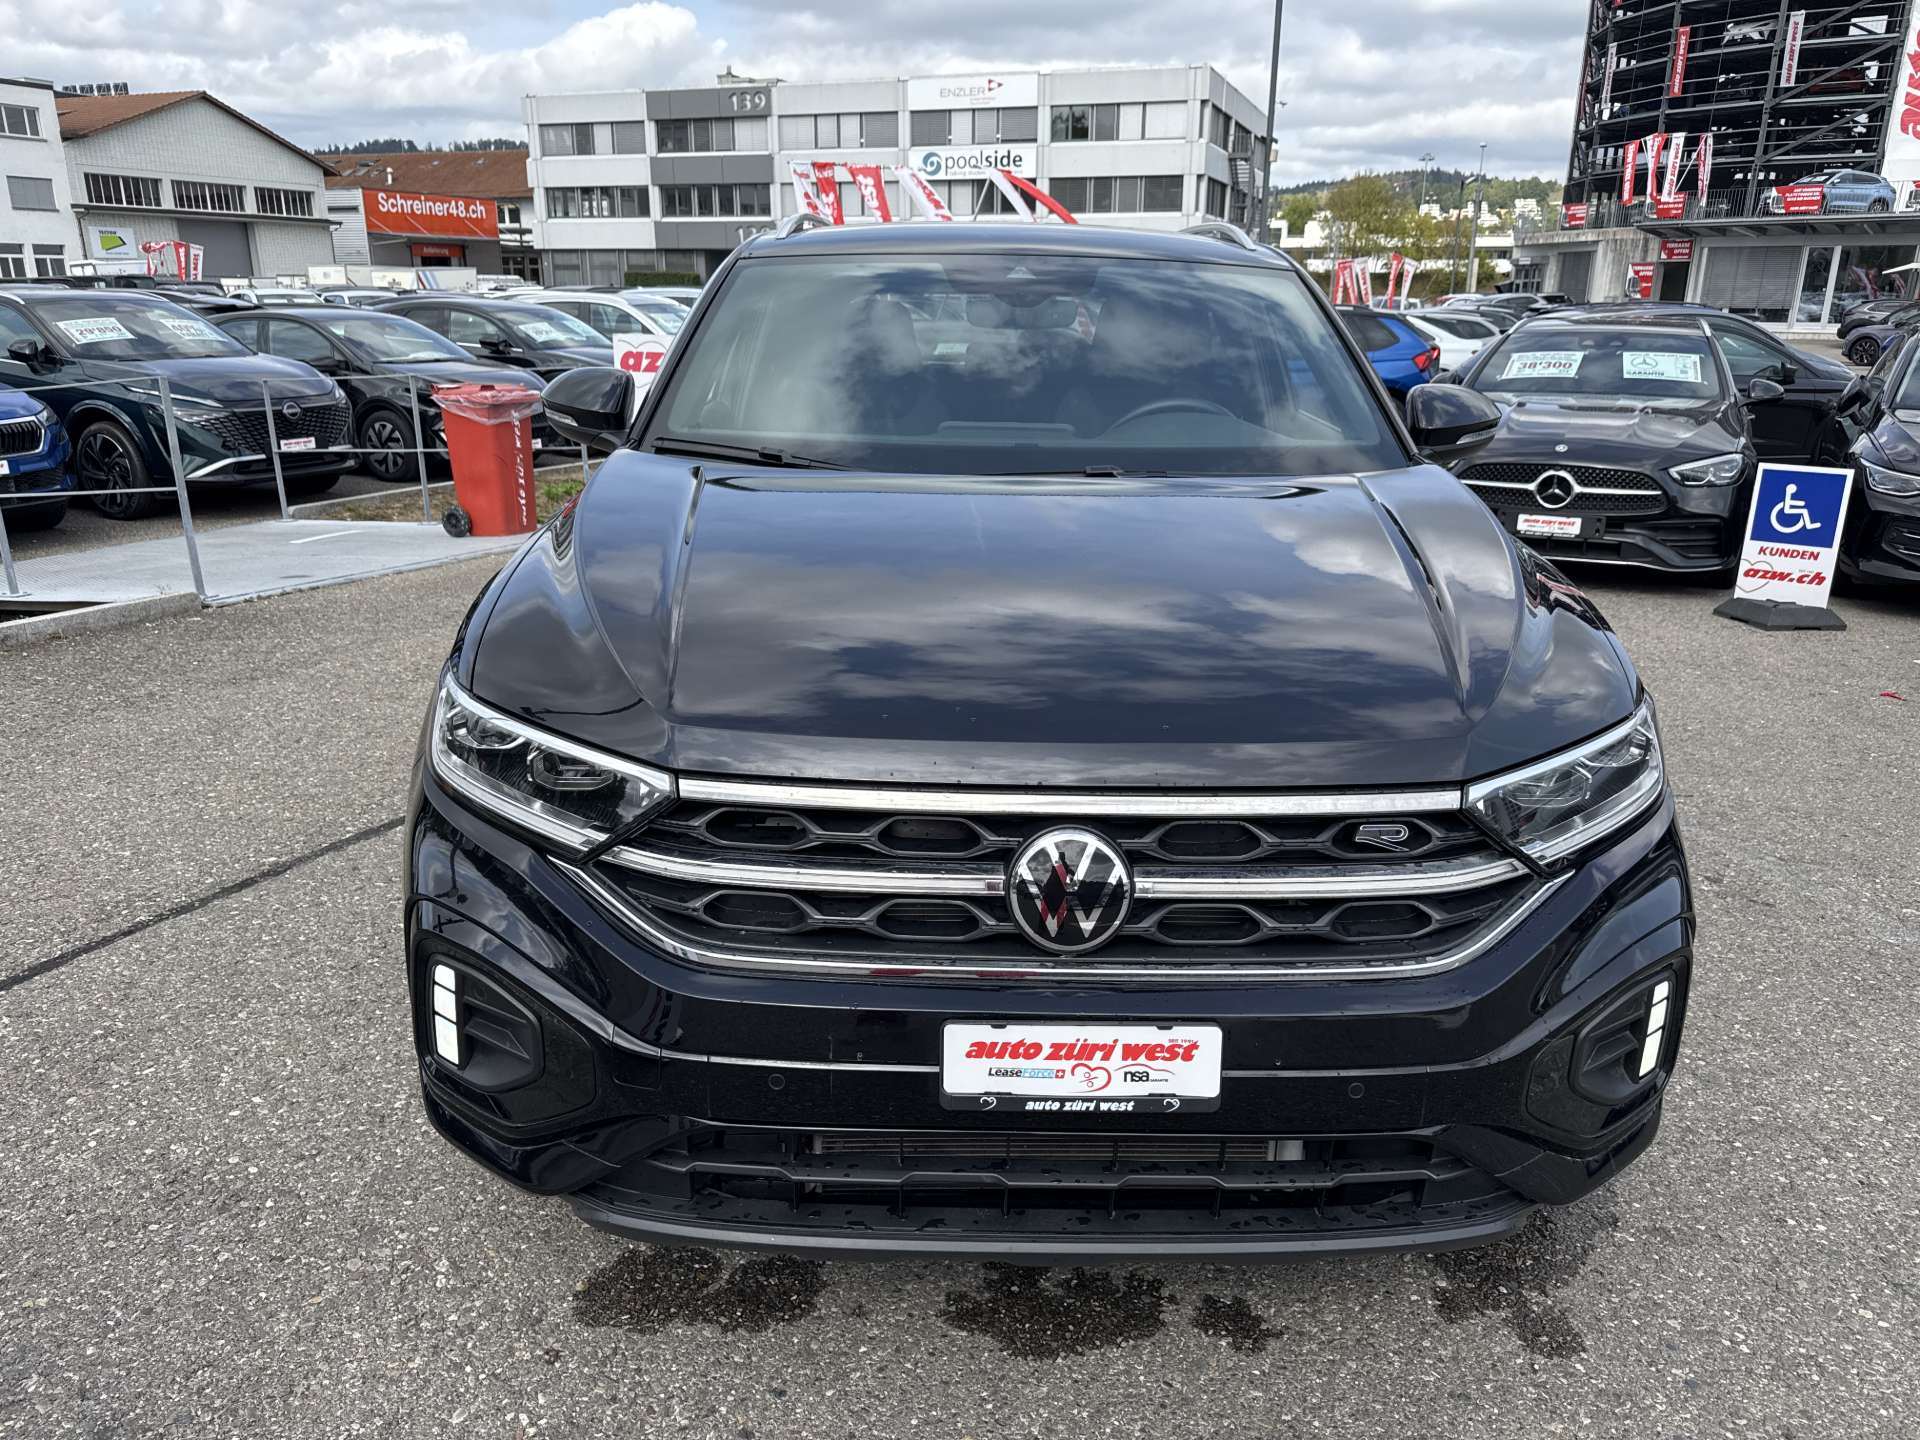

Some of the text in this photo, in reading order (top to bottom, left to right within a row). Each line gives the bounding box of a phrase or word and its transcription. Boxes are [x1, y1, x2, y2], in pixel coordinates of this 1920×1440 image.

[940, 86, 986, 98] ENZLER
[728, 90, 767, 112] 139
[945, 149, 1023, 176] poolside
[377, 191, 487, 220] Schreiner48.ch
[1519, 360, 1573, 369] 38'300
[1758, 546, 1820, 561] KUNDEN
[1743, 568, 1826, 585] azw.ch
[965, 1038, 1200, 1062] auto züri west
[1123, 1070, 1149, 1083] nsa
[1025, 1100, 1135, 1112] auto züri west
